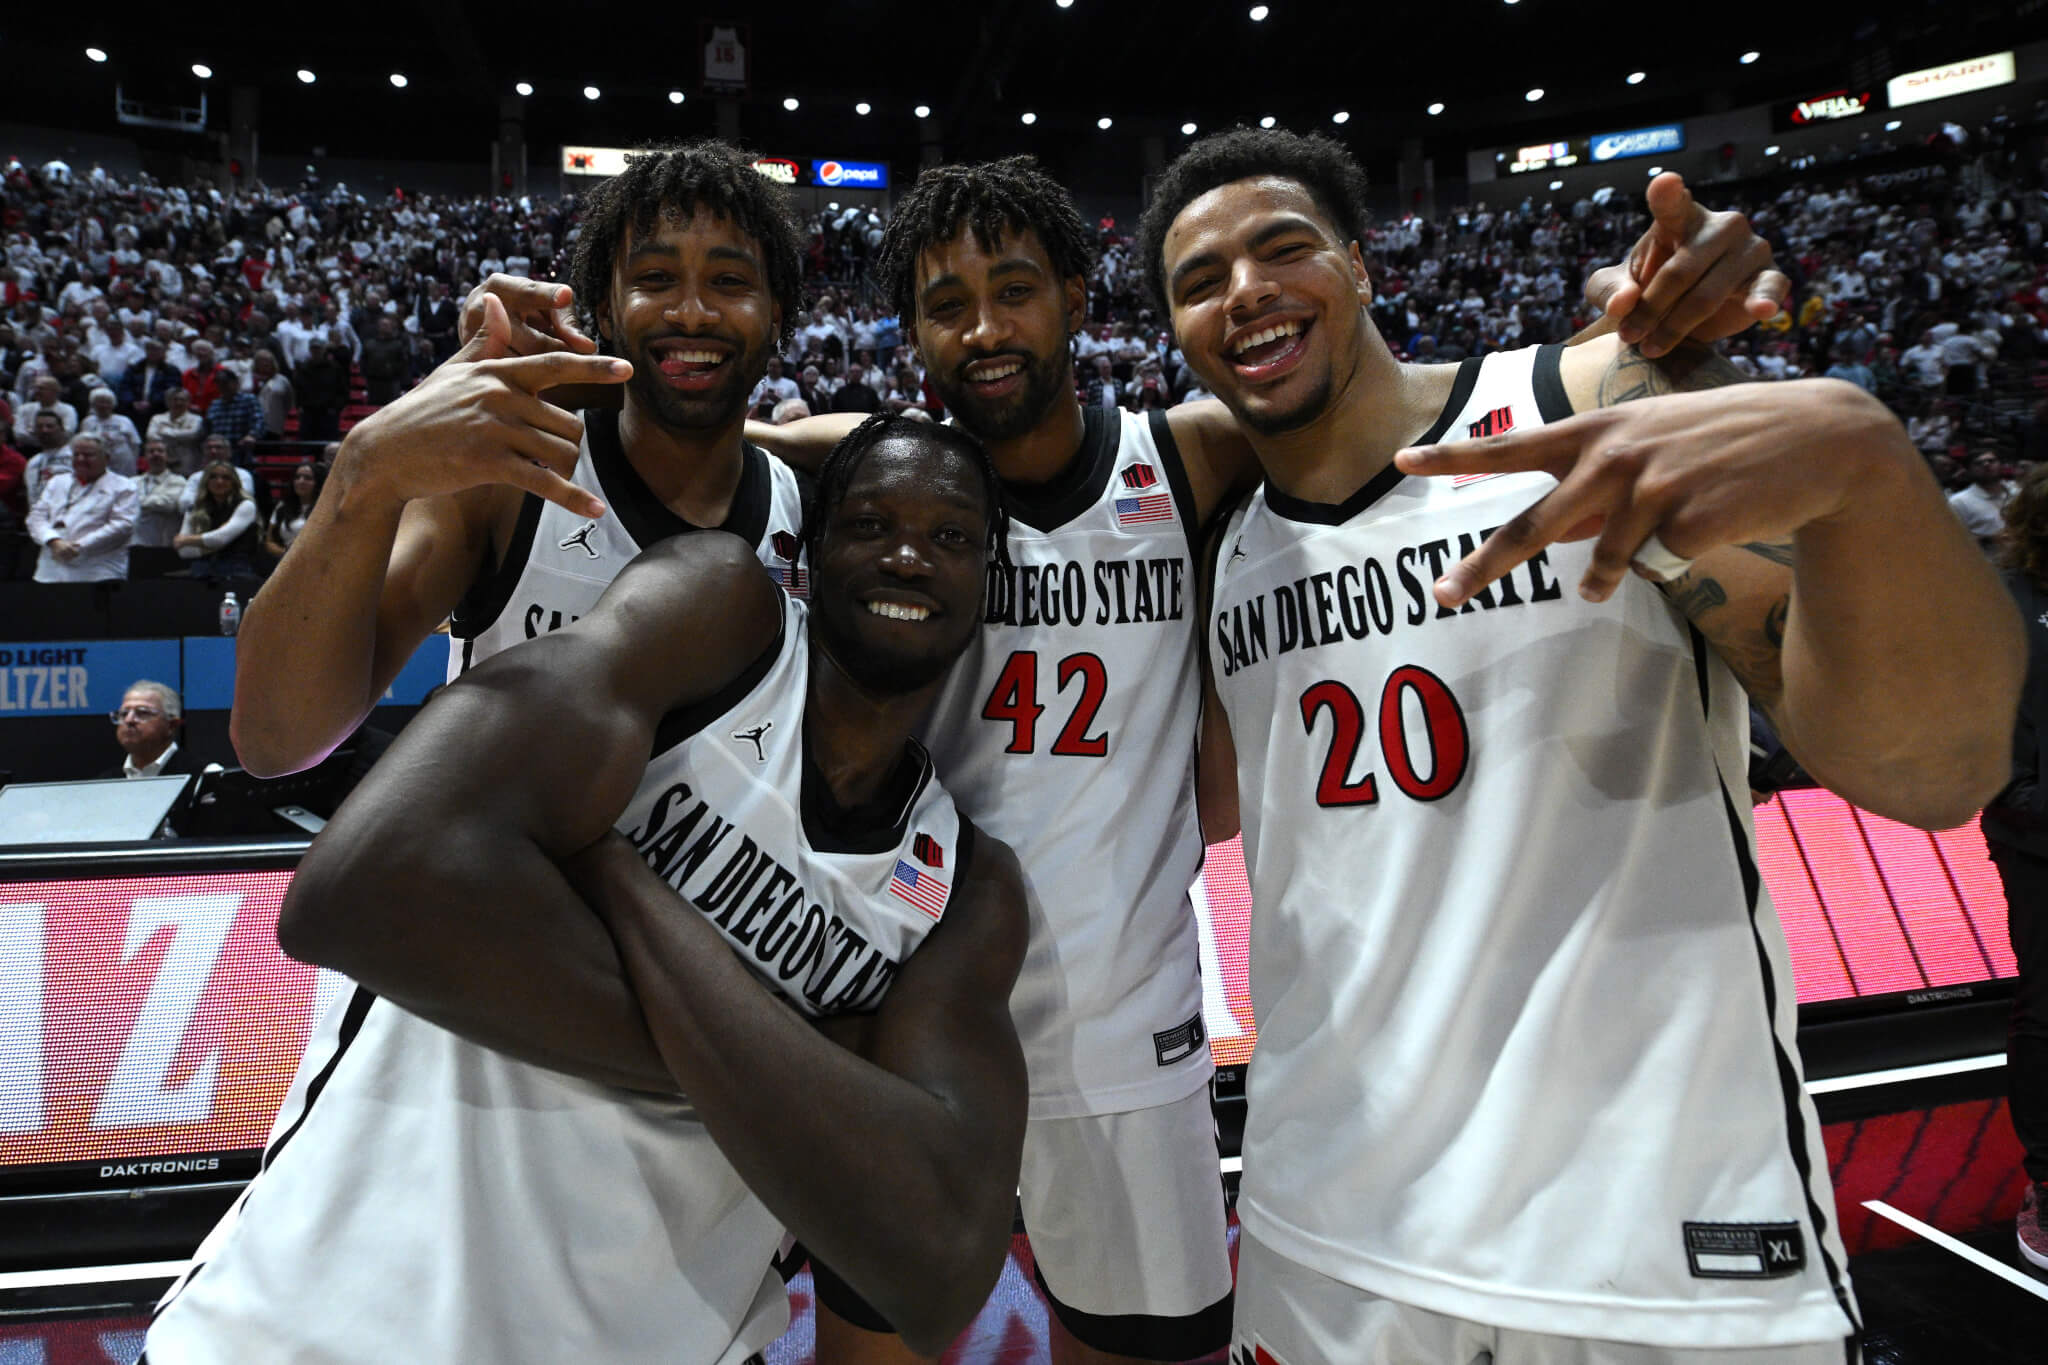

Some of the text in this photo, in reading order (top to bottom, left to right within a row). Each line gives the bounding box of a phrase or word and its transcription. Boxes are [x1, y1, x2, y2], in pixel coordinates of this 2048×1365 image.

[1907, 60, 1996, 87] SHARP
[843, 168, 878, 181] pepsi
[983, 558, 1184, 627] DIEGO STATE
[1217, 594, 1269, 677] SAN
[1273, 557, 1394, 656] DIEGO
[17, 648, 88, 667] LIGHT
[981, 651, 1109, 758] 42
[1300, 664, 1469, 808] 20
[626, 783, 898, 1010] SAN DIEGO STAT
[1193, 1028, 1200, 1041] L
[100, 1158, 219, 1178] DAKTRONICS
[1768, 1240, 1799, 1262] XL
